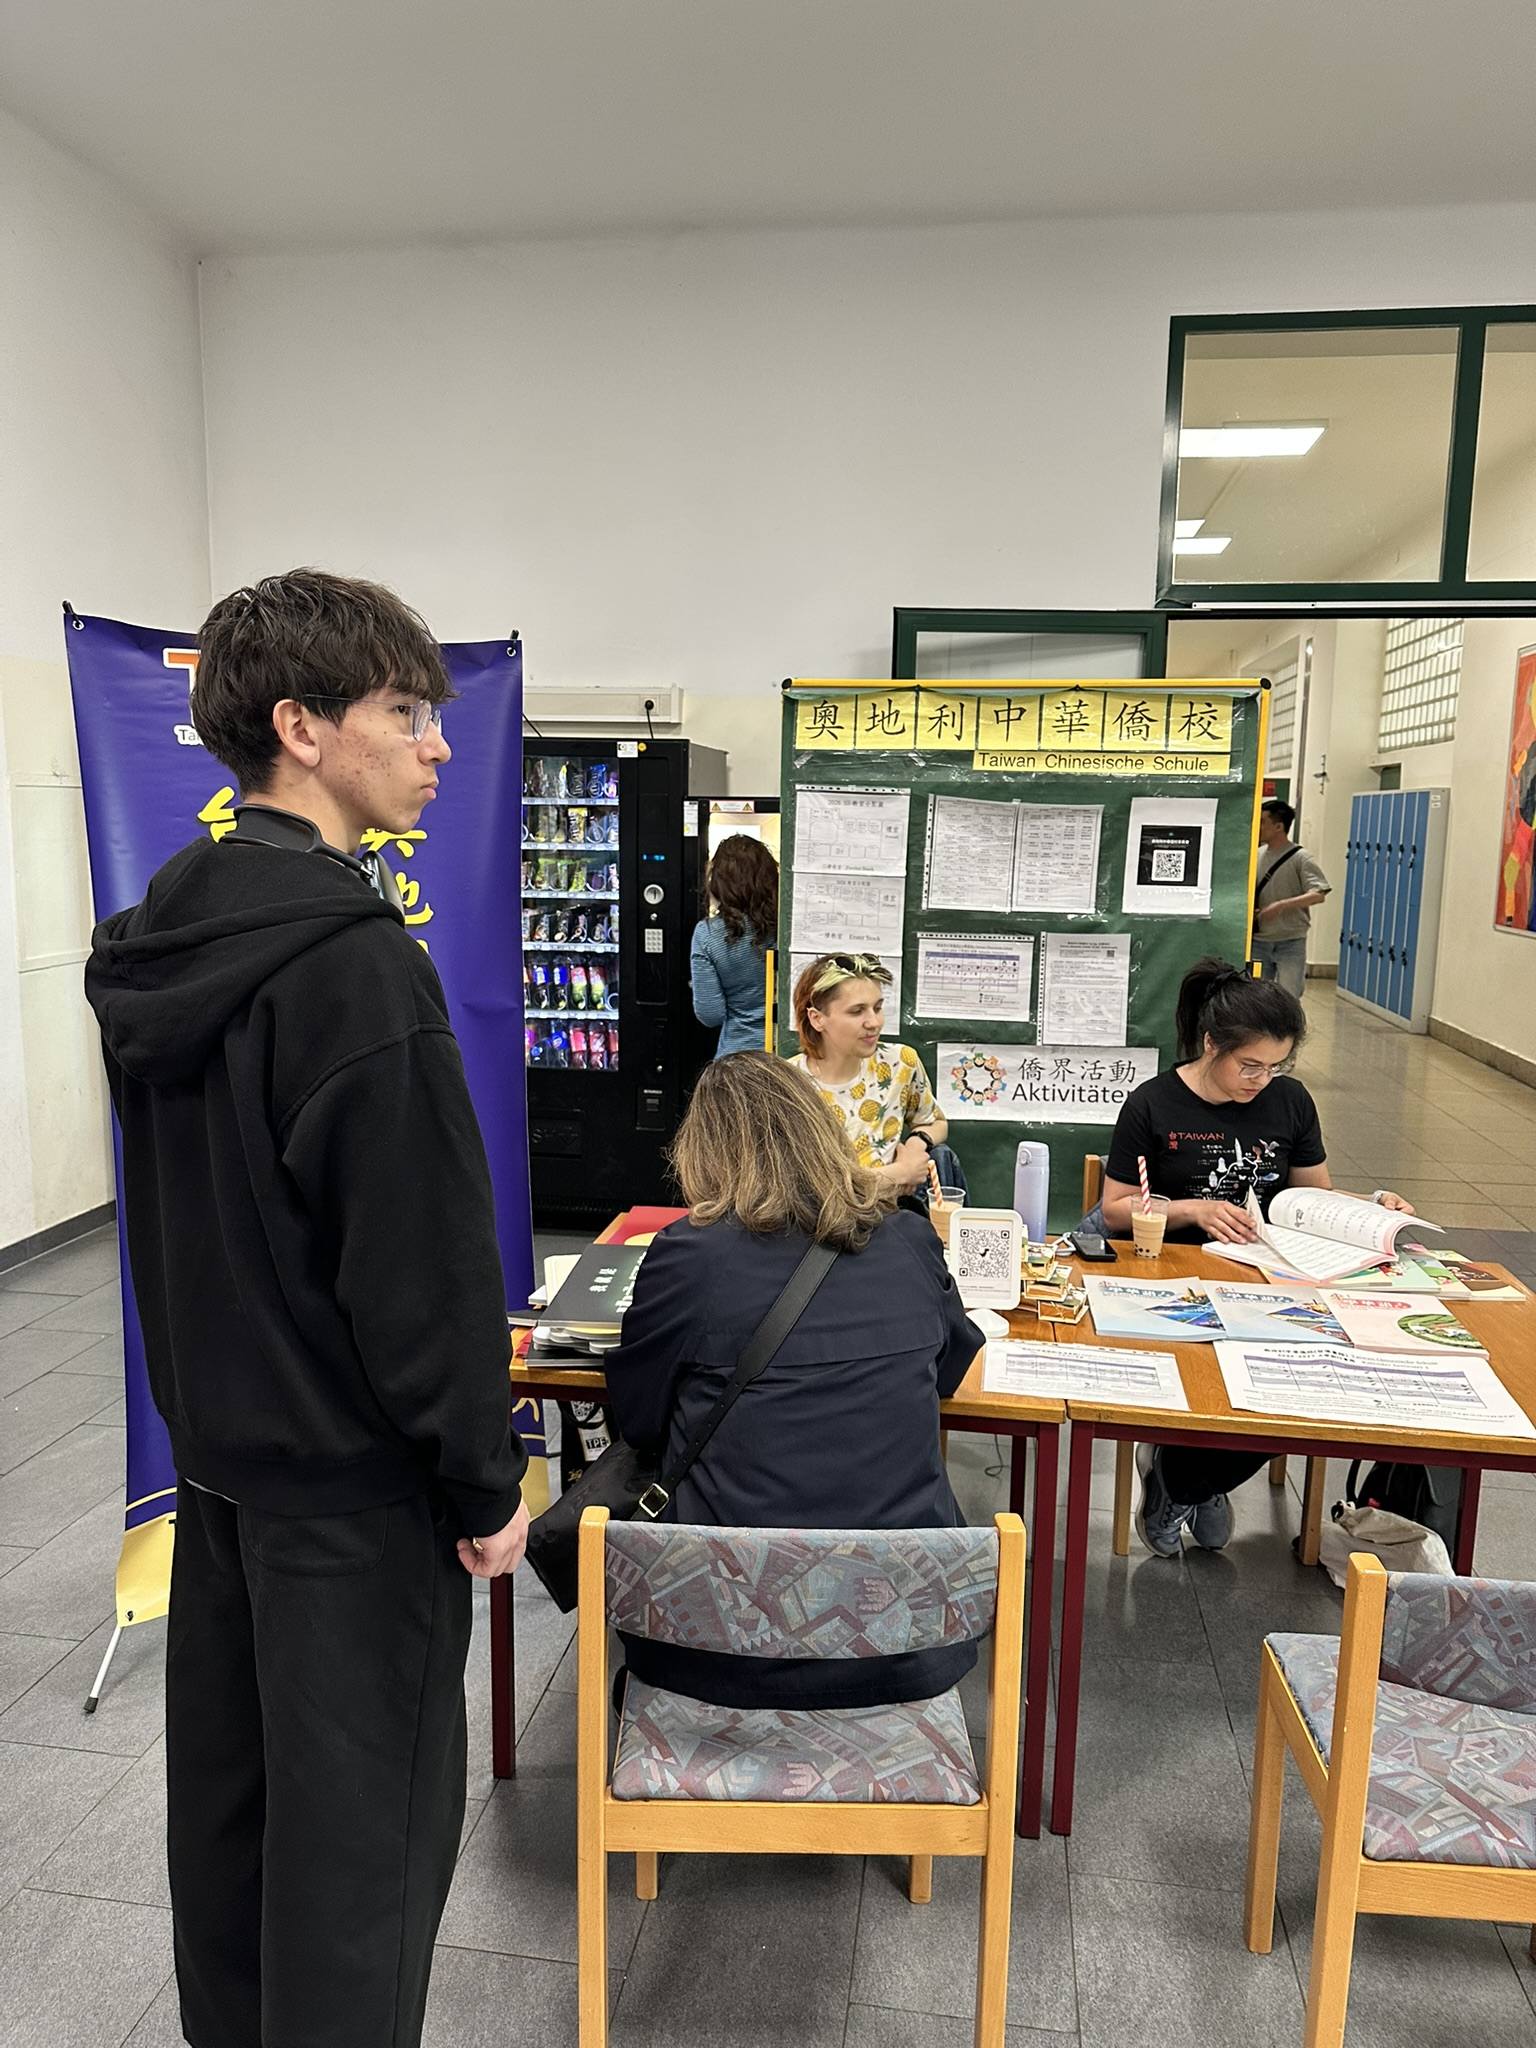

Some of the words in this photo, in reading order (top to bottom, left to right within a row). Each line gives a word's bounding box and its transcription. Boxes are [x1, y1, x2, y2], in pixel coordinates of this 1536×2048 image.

[804, 697, 1224, 743] 奧地利中華僑校
[979, 752, 1036, 769] Taiwan
[1045, 753, 1145, 770] Chinesische
[1153, 755, 1209, 772] Schule
[1016, 1056, 1137, 1084] 僑界活動
[1177, 1131, 1225, 1141] TAIWAN
